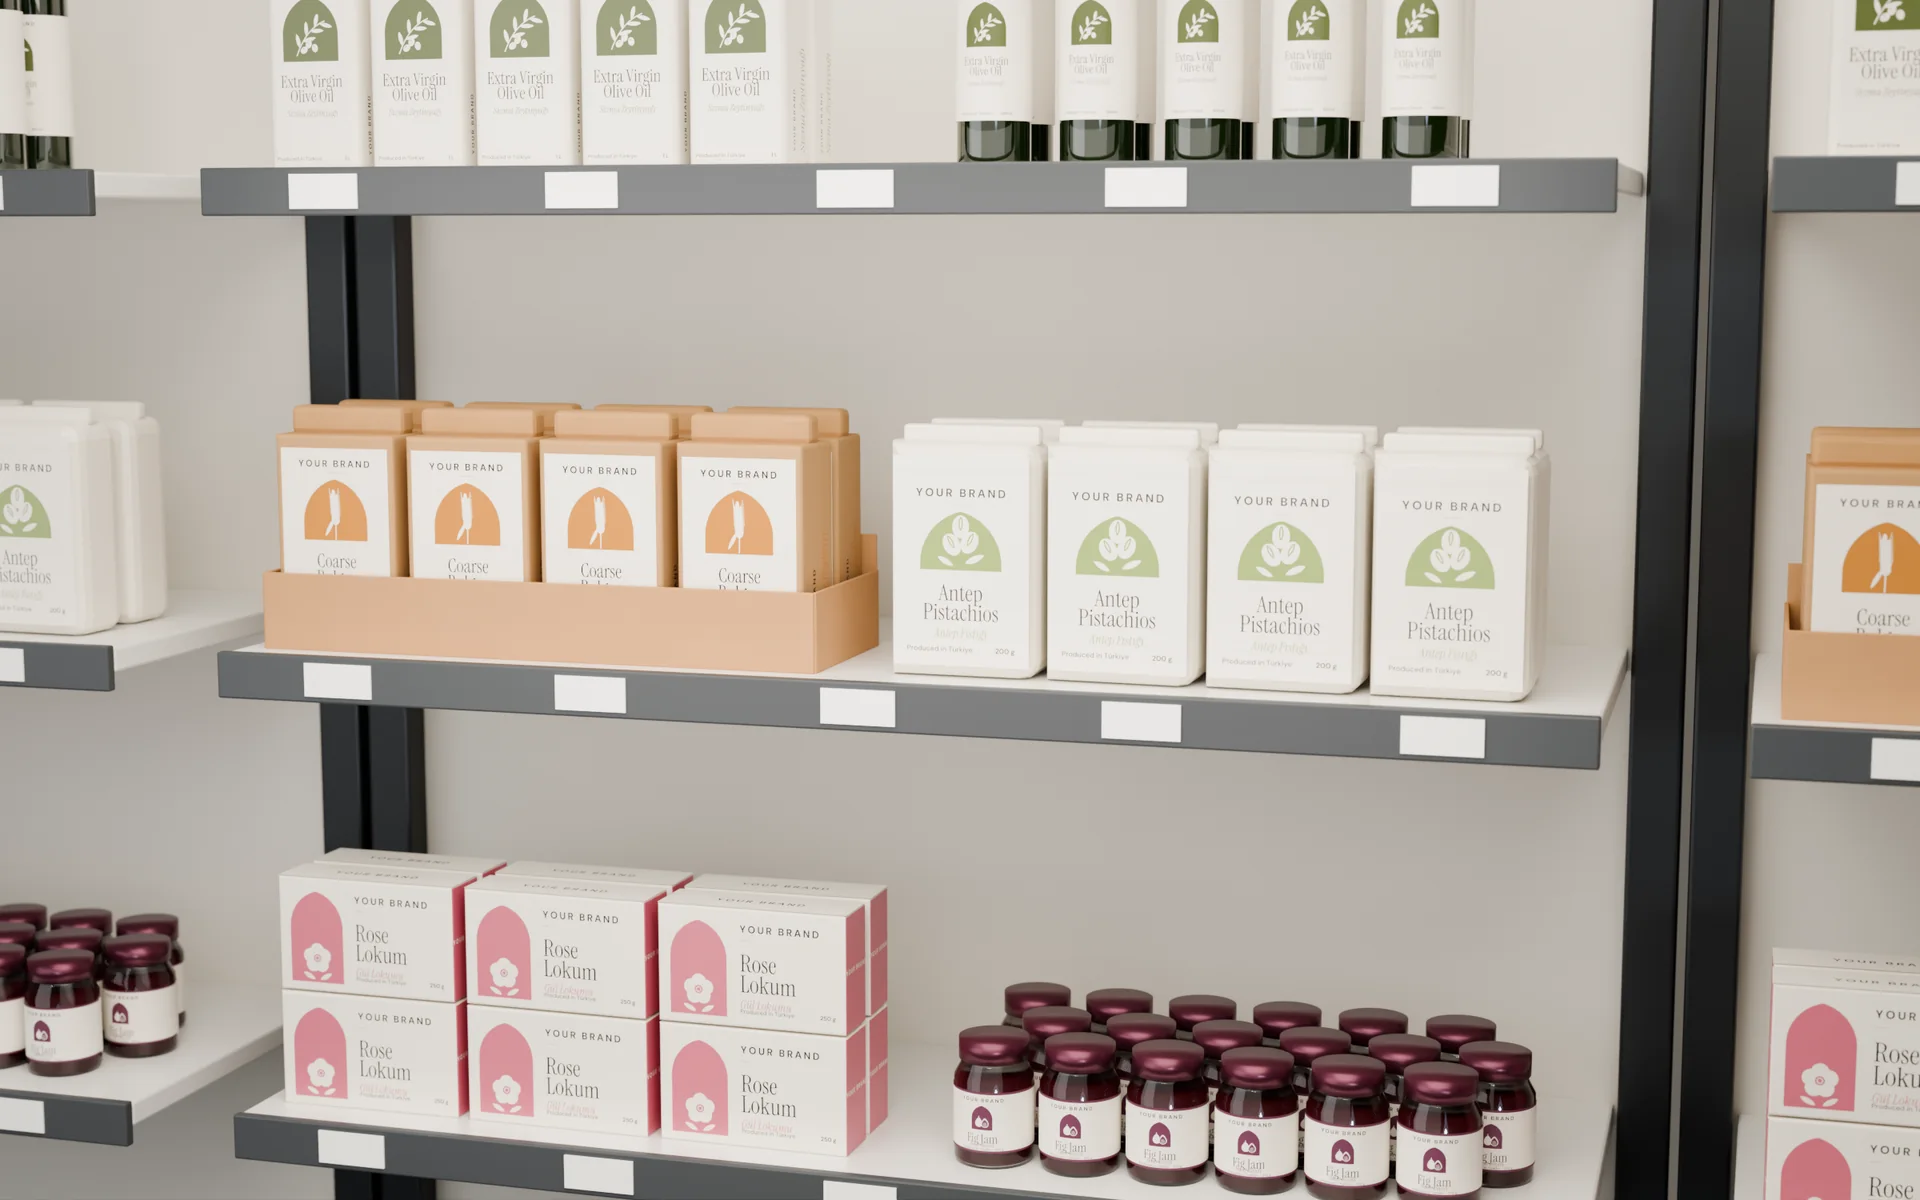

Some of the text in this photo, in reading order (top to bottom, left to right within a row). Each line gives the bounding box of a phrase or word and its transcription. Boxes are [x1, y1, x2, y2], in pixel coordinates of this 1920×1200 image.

[1849, 47, 1887, 63] Extra
[593, 69, 661, 87] Extra Virgin
[702, 67, 770, 85] Extra Virgin
[1861, 64, 1898, 79] Olive
[281, 74, 343, 92] Extra Virgin
[383, 72, 446, 91] Extra Virgin
[487, 71, 554, 89] Extra Virgin
[290, 87, 334, 103] Olive Oil
[392, 86, 437, 102] Olive Oil
[496, 85, 544, 100] Olive Oil
[603, 83, 651, 98] Olive Oil
[712, 81, 760, 97] Olive Oil
[15, 463, 53, 473] BRAND
[299, 459, 370, 469] YOUR BRAND
[429, 462, 504, 473] YOUR BRAND
[562, 465, 638, 476] YOUR BRAND
[700, 469, 778, 480] YOUR BRAND
[916, 487, 1007, 499] YOUR BRAND
[1072, 491, 1165, 504] YOUR BRAND
[1234, 495, 1330, 508] YOUR BRAND
[1402, 500, 1502, 513] YOUR BRAND
[1840, 498, 1880, 509] YOUR
[2, 550, 38, 570] Antep
[317, 553, 357, 570] Coarse
[448, 558, 489, 575] Coarse
[580, 563, 623, 580] Coarse
[718, 568, 761, 585] Coarse
[938, 584, 983, 607] Antep
[1094, 590, 1140, 613] Antep
[923, 602, 999, 624] Pistachios
[1256, 596, 1304, 619] Antep
[1424, 602, 1474, 626] Antep
[1078, 608, 1156, 630] Pistachios
[1240, 615, 1321, 636] Pistachios
[1856, 608, 1911, 627] Coarse
[1407, 621, 1491, 643] Pistachios
[1315, 662, 1331, 670] 200
[1485, 669, 1501, 677] 200
[354, 896, 428, 909] YOUR BRAND
[759, 900, 806, 908] BRAND
[543, 910, 619, 924] YOUR BRAND
[356, 924, 389, 944] Rose
[740, 925, 819, 939] YOUR BRAND
[356, 944, 407, 965] Lokum
[544, 939, 578, 959] Rose
[544, 959, 597, 981] Lokum
[741, 954, 776, 975] Rose
[741, 975, 796, 998] Lokum
[358, 1012, 432, 1026] YOUR BRAND
[1876, 1009, 1917, 1022] YOUR
[545, 1029, 621, 1043] YOUR BRAND
[359, 1040, 393, 1059] Rose
[741, 1045, 820, 1061] YOUR BRAND
[1874, 1042, 1920, 1066] Rose
[360, 1060, 411, 1081] Lokum
[546, 1057, 581, 1077] Rose
[547, 1077, 599, 1099] Lokum
[742, 1074, 778, 1095] Rose
[742, 1095, 797, 1118] Lokum
[963, 1095, 979, 1103] YOUR
[1050, 1103, 1068, 1111] YOUR
[1139, 1111, 1157, 1119] YOUR
[1228, 1119, 1245, 1127] YOUR
[967, 1131, 998, 1148] Fig Jam
[1321, 1128, 1340, 1136] YOUR
[1413, 1136, 1432, 1144] YOUR
[1055, 1140, 1087, 1156] Fig Jam
[1143, 1148, 1176, 1164] Fig Jam
[1870, 1144, 1911, 1157] YOUR
[1232, 1156, 1265, 1173] Fig Jam
[1325, 1165, 1360, 1181] Fig Jam
[1417, 1174, 1452, 1190] Fig Jam
[1868, 1176, 1914, 1200] Rose
